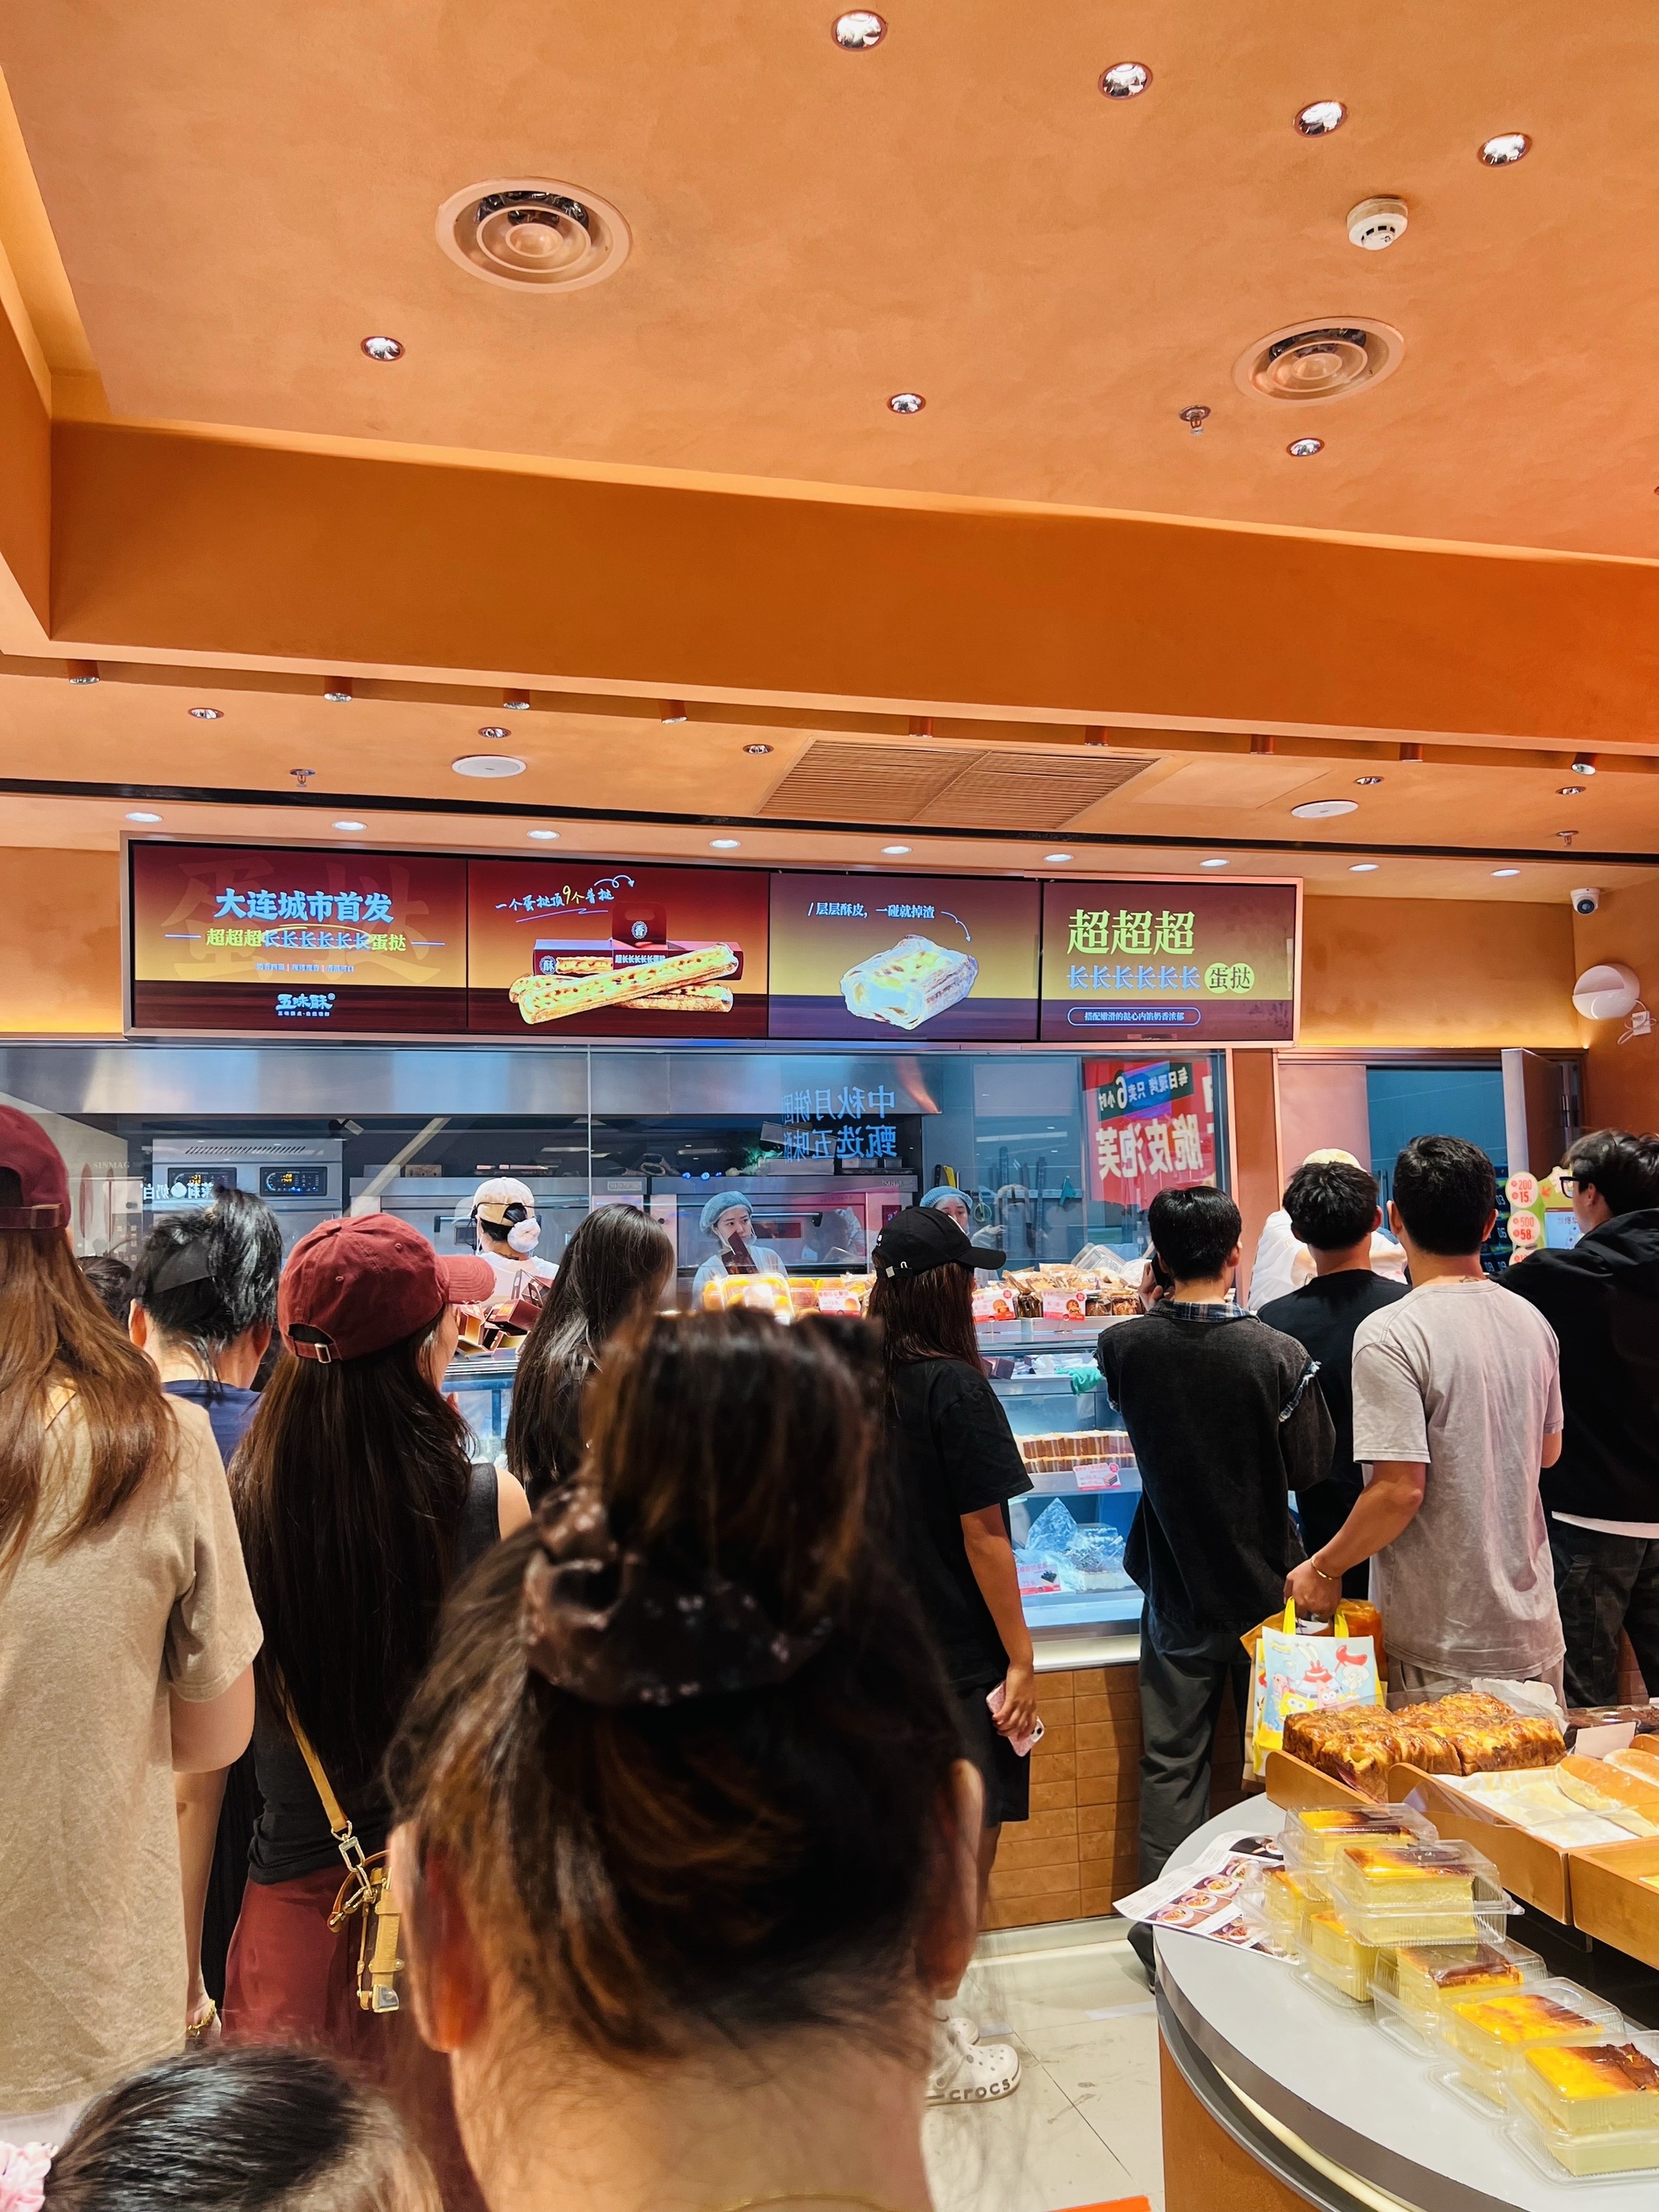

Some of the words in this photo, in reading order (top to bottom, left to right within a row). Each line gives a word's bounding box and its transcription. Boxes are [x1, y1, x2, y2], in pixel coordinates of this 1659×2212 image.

[214, 887, 395, 923] 大连城市首发
[634, 923, 645, 936] 香
[1067, 909, 1195, 955] 超超超
[275, 993, 333, 1011] 五味酥
[1518, 1179, 1532, 1190] 200
[1521, 1217, 1535, 1227] 500
[949, 2078, 1011, 2101] crocs
